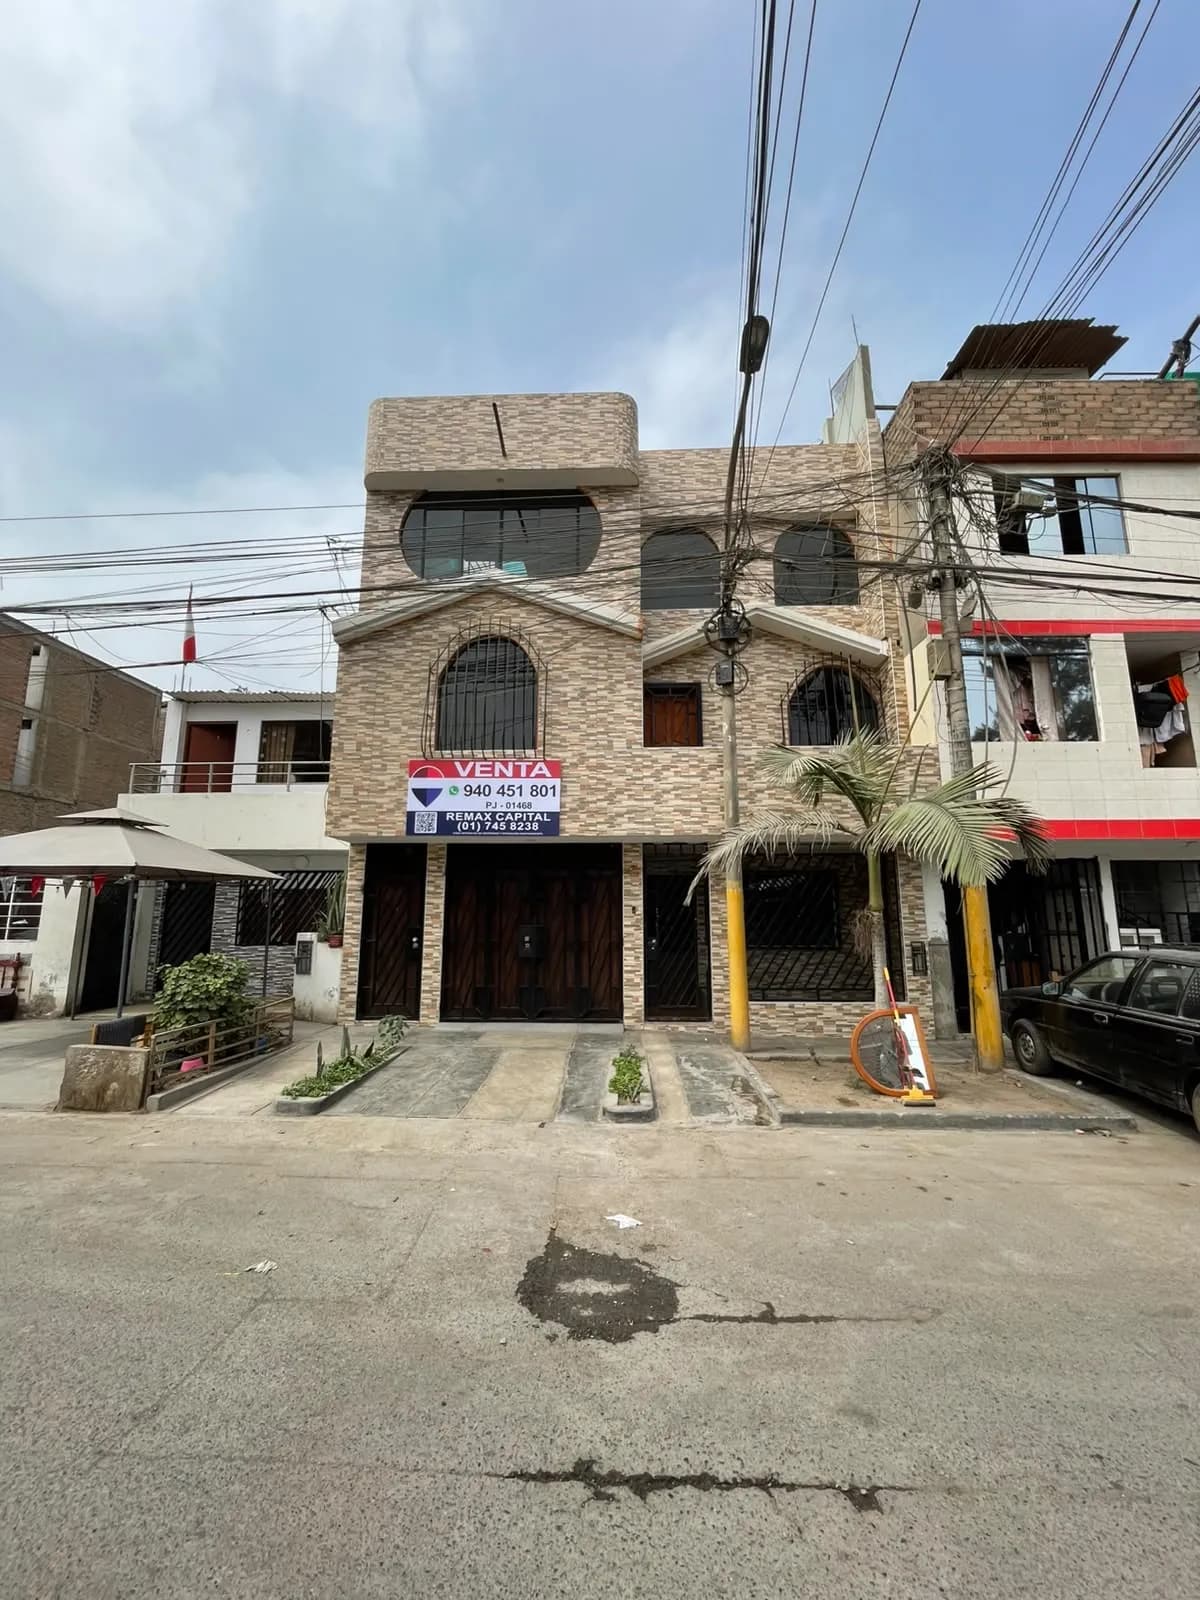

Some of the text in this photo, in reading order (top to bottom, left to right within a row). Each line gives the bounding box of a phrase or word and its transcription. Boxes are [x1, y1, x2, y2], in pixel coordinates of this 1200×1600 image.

[454, 761, 552, 777] VENTA
[463, 784, 556, 797] 940 451 801
[505, 801, 532, 809] 01468
[446, 812, 551, 821] REMAX CAPITAL
[457, 822, 539, 832] (01) 745 8238
